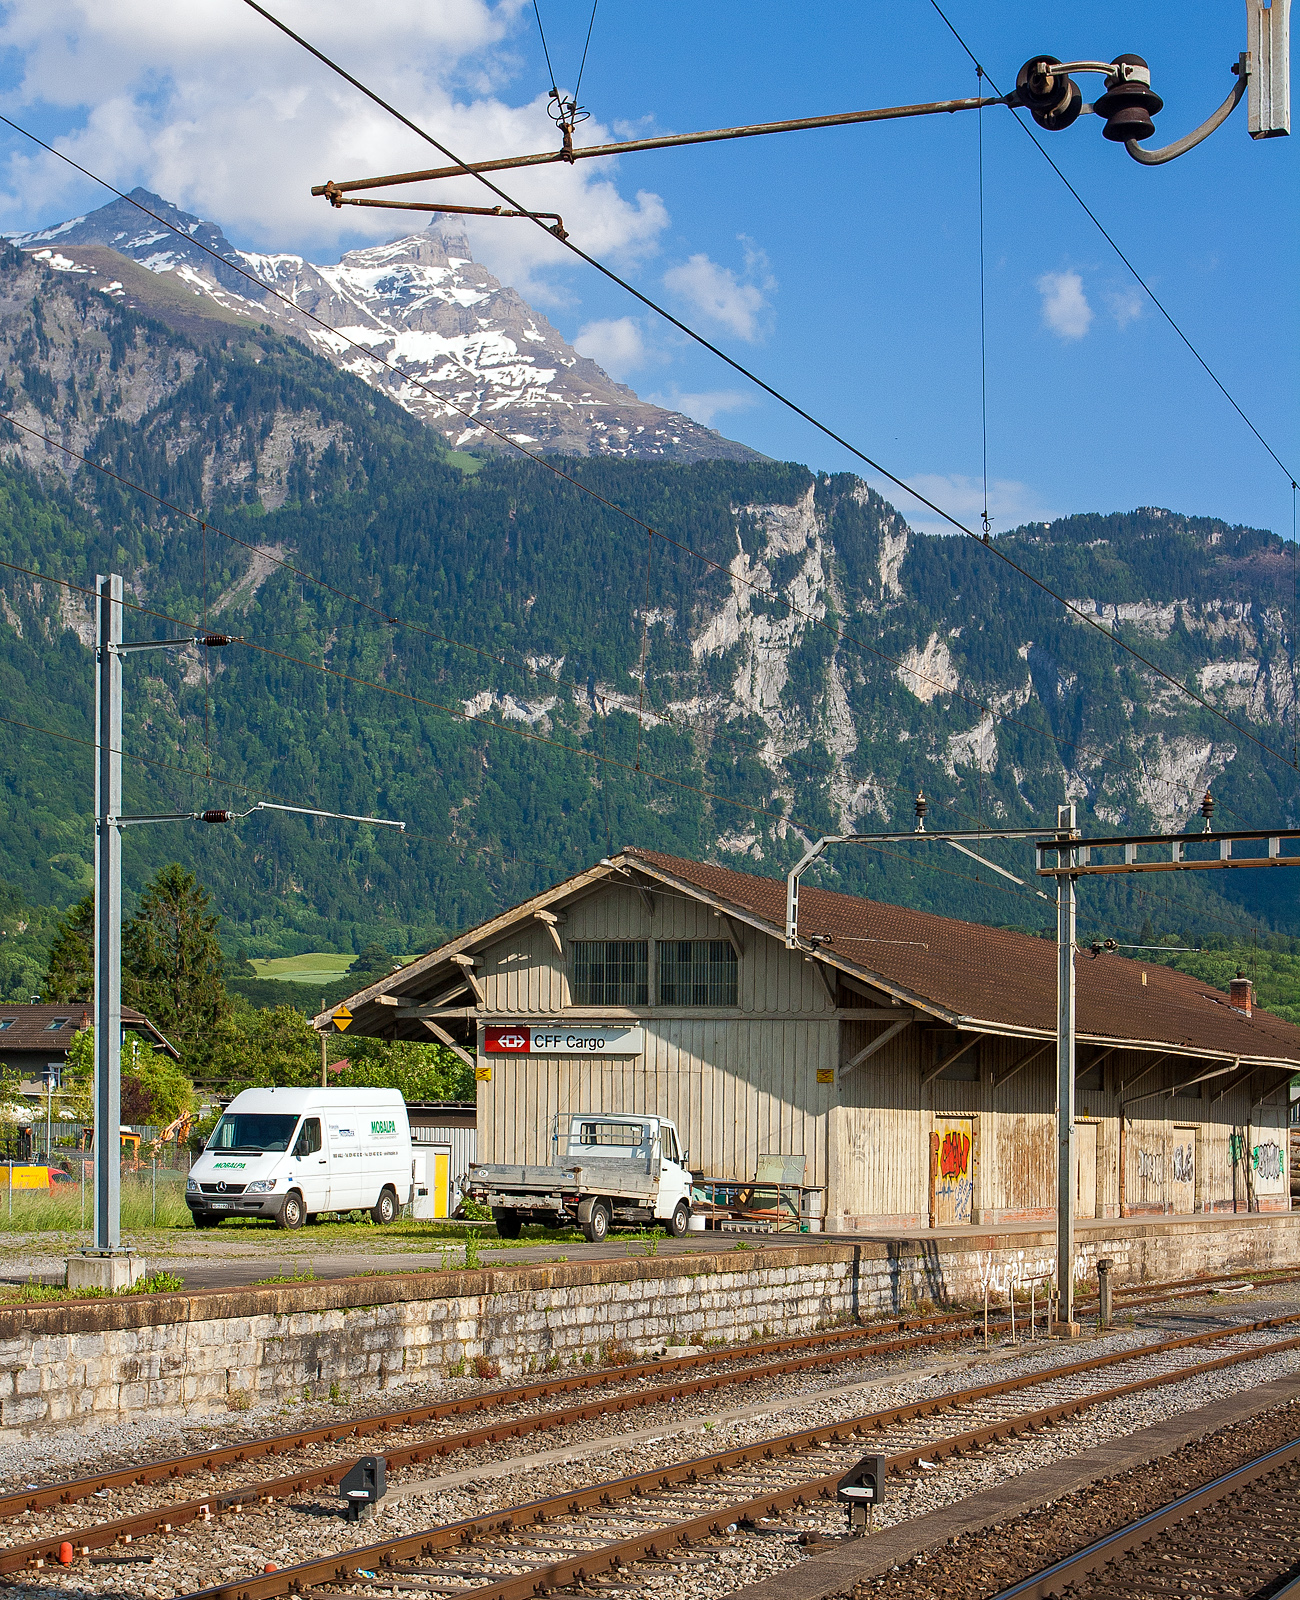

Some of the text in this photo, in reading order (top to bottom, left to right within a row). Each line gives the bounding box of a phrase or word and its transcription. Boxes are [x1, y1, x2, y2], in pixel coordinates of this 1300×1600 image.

[534, 1034, 605, 1051] CFF Cargo
[371, 1121, 396, 1133] MOBALPA
